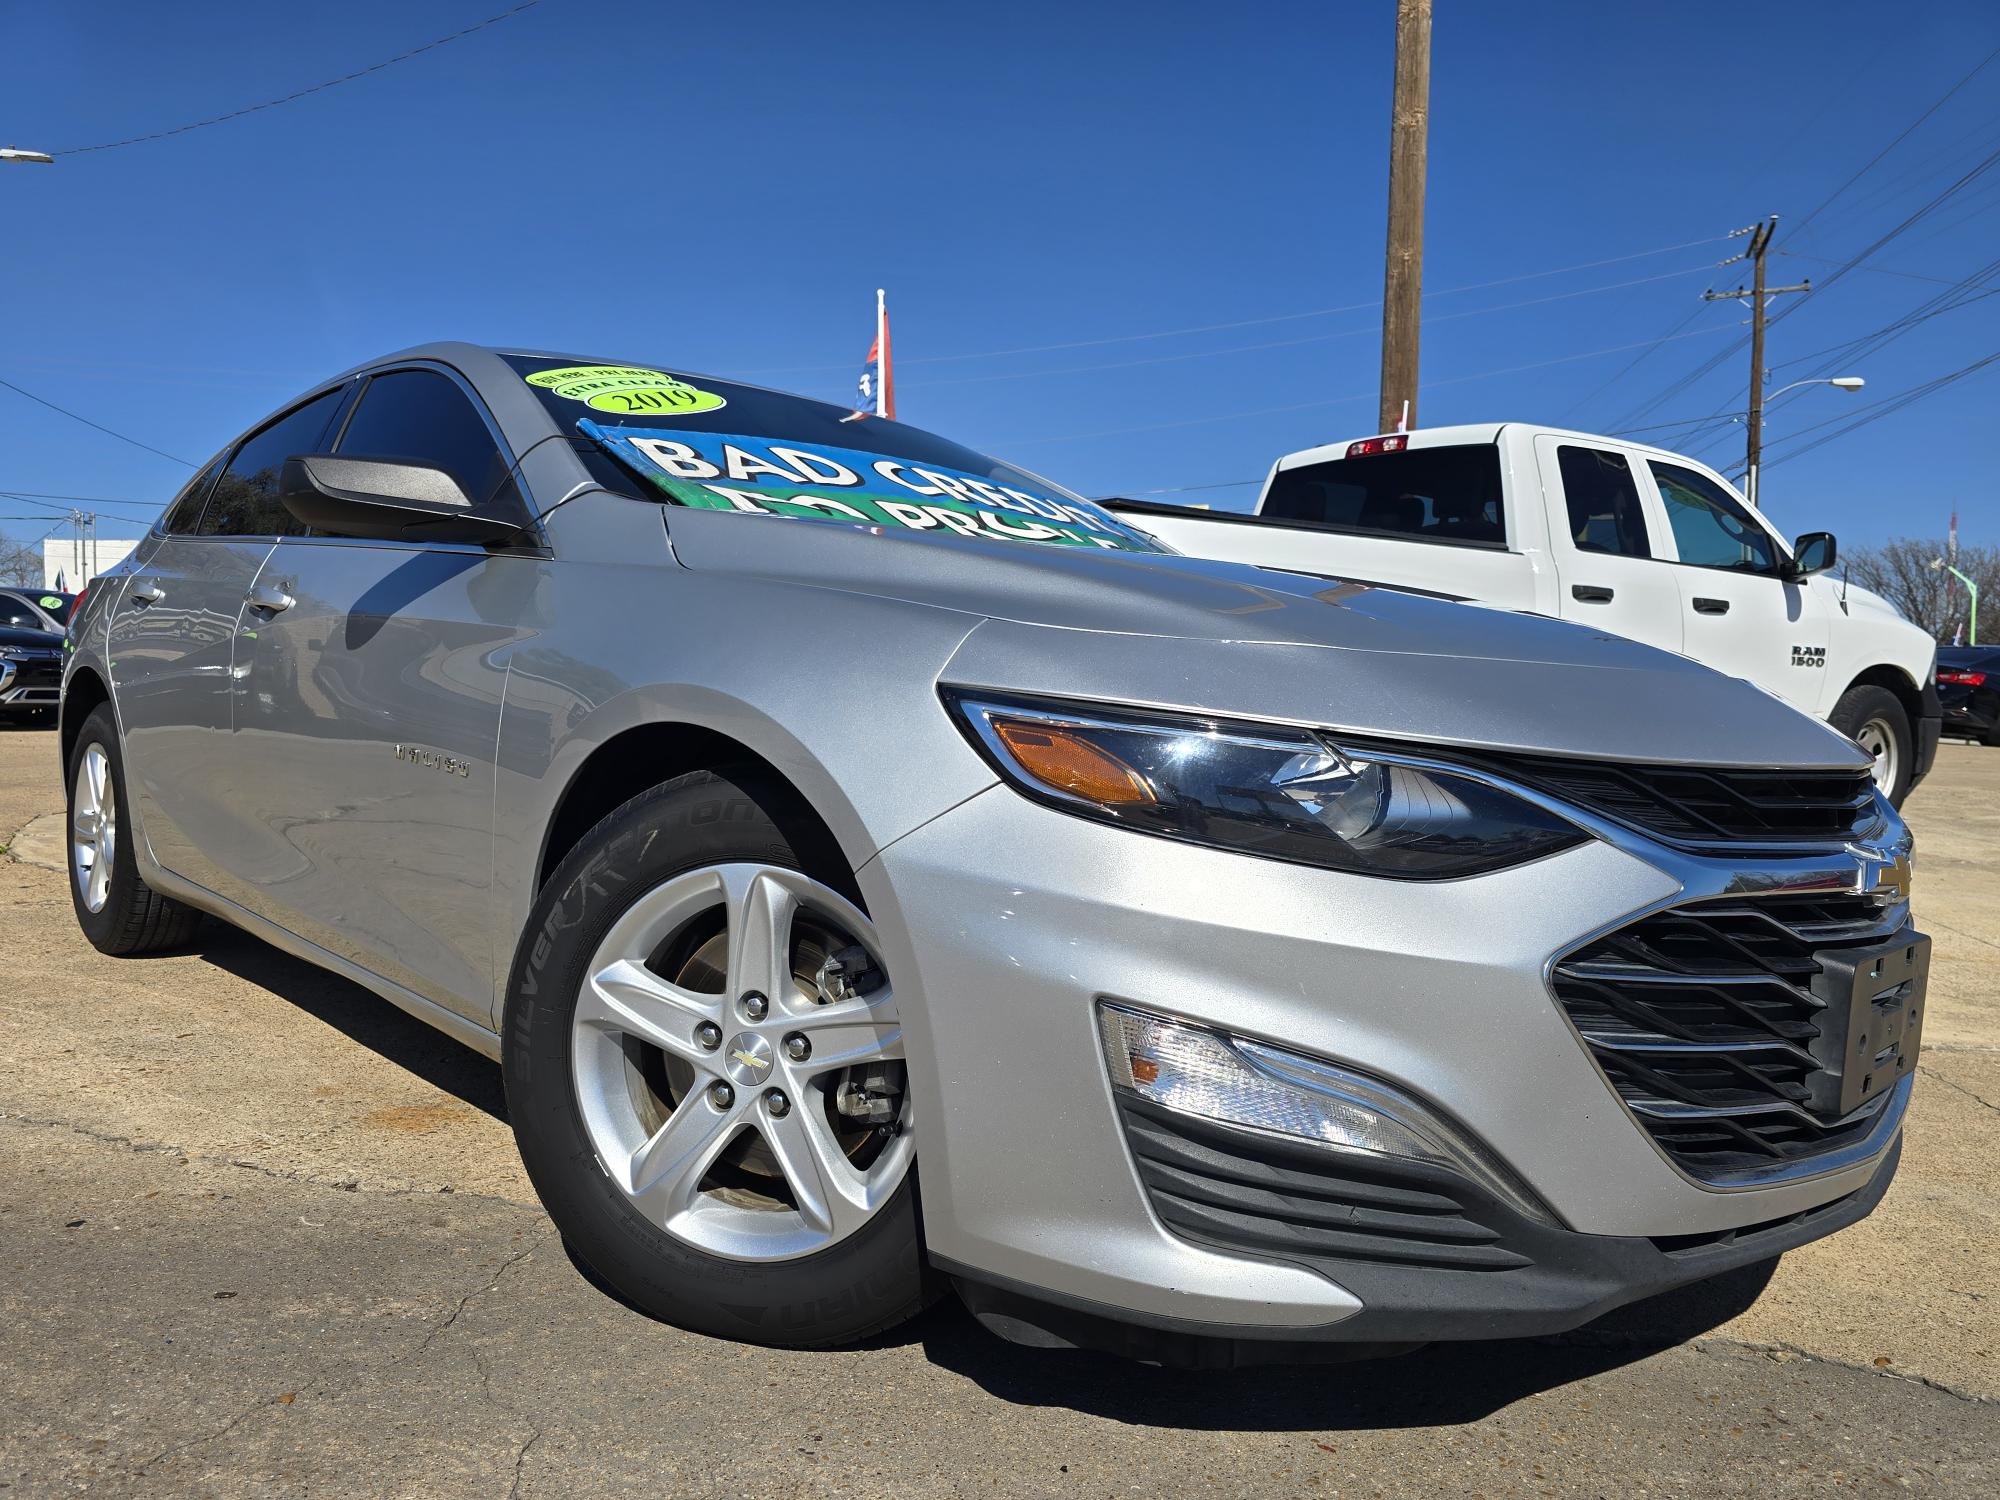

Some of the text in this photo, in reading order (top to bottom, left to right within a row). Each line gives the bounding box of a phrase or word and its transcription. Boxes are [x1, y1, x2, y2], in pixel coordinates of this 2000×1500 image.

[563, 379, 684, 397] EXTRA CLEAN
[611, 388, 698, 411] 2019
[625, 436, 862, 488] BAD
[1791, 645, 1826, 656] RAM
[1791, 656, 1825, 668] 1500
[393, 743, 471, 777] MALIBU
